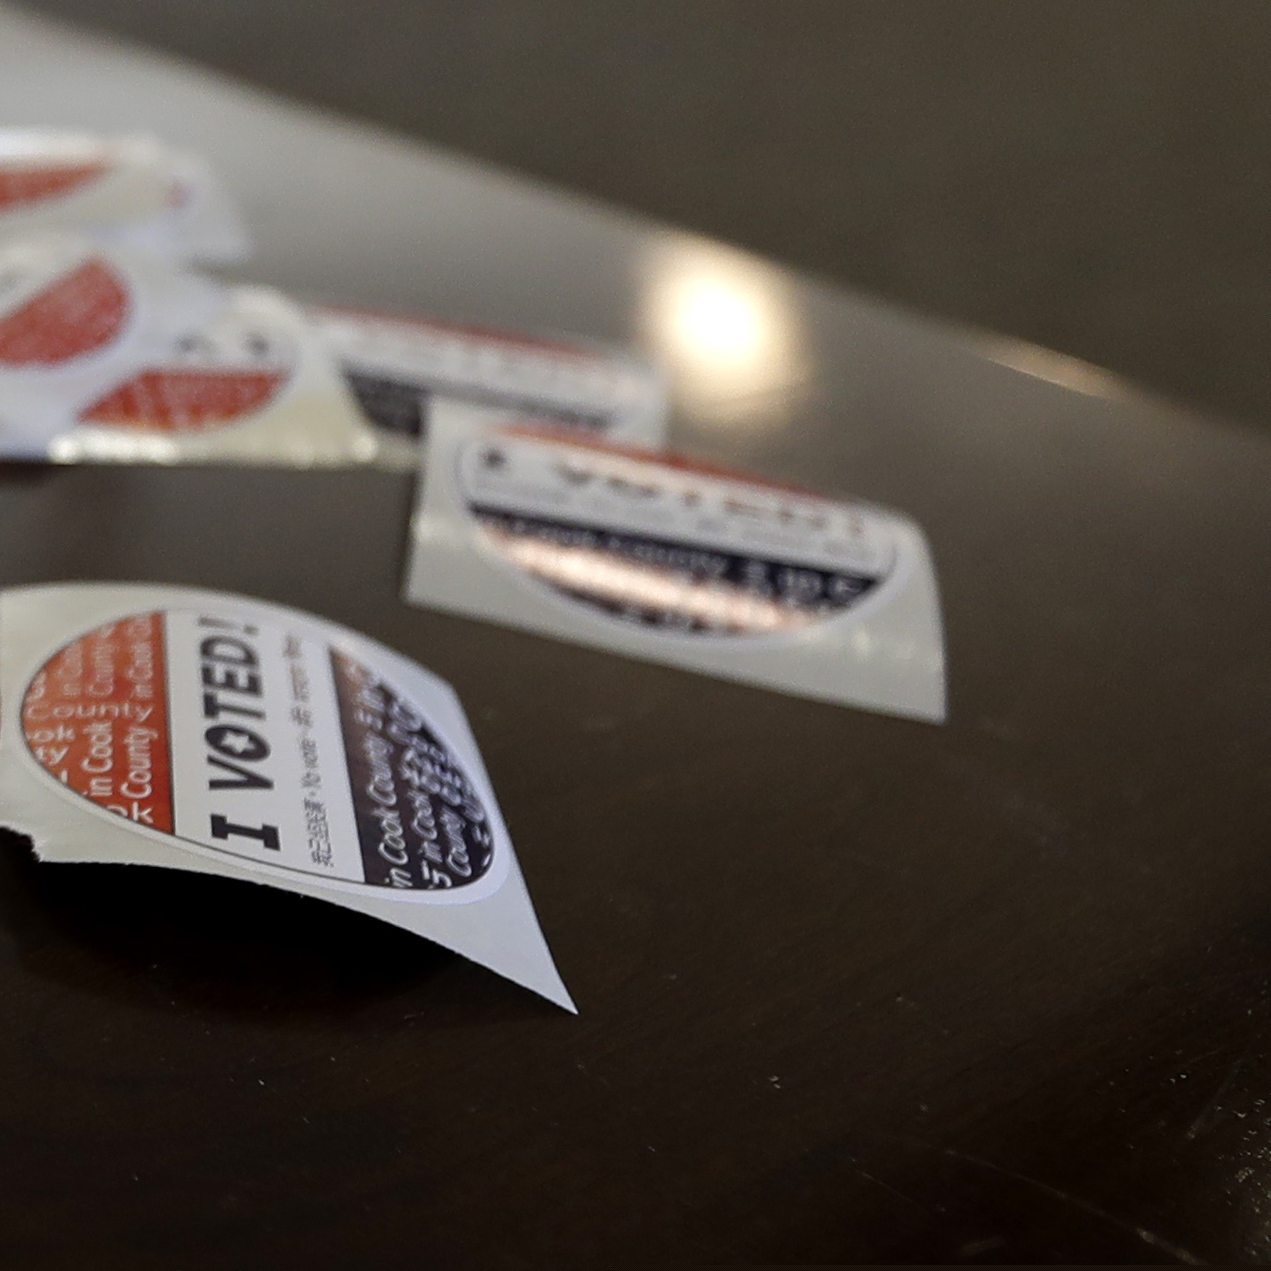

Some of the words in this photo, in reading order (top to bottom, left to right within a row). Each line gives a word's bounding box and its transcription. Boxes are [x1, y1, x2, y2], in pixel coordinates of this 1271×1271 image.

[27, 700, 154, 721] County
[198, 615, 274, 791] VOTED!
[81, 721, 113, 773] Cook
[120, 726, 158, 799] County
[83, 779, 113, 797] in
[210, 814, 281, 851] I
[373, 806, 408, 864] Cook
[385, 867, 412, 888] in
